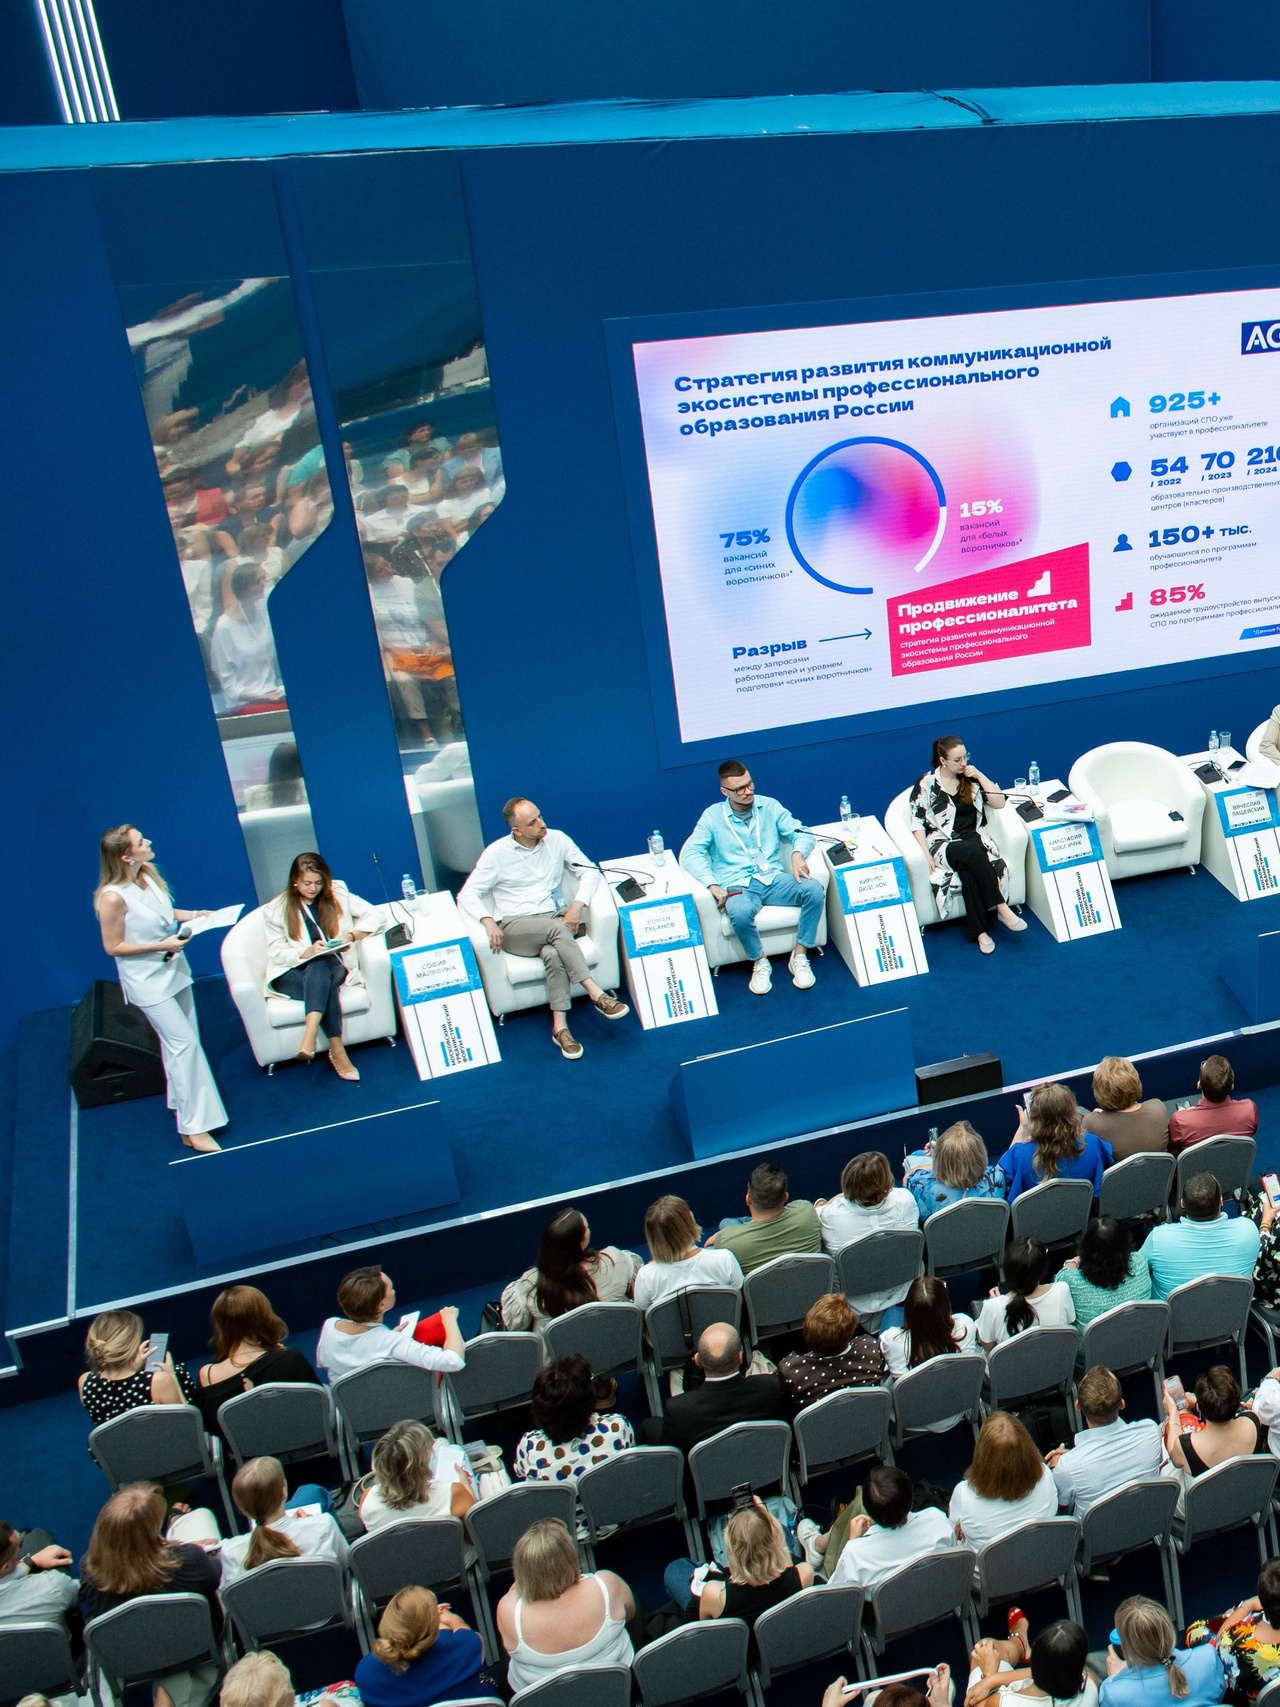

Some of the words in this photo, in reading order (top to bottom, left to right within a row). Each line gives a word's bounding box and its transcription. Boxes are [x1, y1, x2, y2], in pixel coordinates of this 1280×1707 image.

[674, 369, 797, 393] Стратегия
[801, 358, 904, 383] развития
[908, 336, 1112, 369] коммуникационной
[677, 388, 818, 414] экосистемы
[822, 366, 1040, 401] профессионального
[1149, 390, 1221, 414] 925+
[679, 409, 830, 437] образования
[833, 400, 914, 419] России
[1150, 417, 1199, 430] организаций
[1200, 415, 1218, 424] СПО
[1218, 415, 1234, 425] уже
[1150, 430, 1188, 441] участвуют
[1195, 421, 1269, 436] профессионалитете
[1150, 456, 1189, 477] 54
[1200, 450, 1236, 471] 70
[1157, 478, 1182, 487] 2022
[1208, 471, 1232, 481] 2023
[1254, 466, 1278, 475] 2024
[960, 498, 1004, 518] 15%
[1151, 501, 1182, 511] центров
[1183, 496, 1225, 508] (кластеров)
[960, 519, 1000, 531] вакансий
[719, 528, 771, 549] 75%
[960, 534, 976, 543] для
[978, 530, 1008, 540] «белых
[1149, 525, 1215, 548] 150+
[1219, 525, 1252, 537] тыс.
[723, 550, 768, 563] вакансий
[1149, 549, 1200, 561] обучающихся
[1211, 542, 1257, 554] программам
[724, 566, 742, 575] для
[744, 562, 776, 572] «синих
[1150, 555, 1223, 571] профессионалитета
[897, 590, 1019, 618] Продвижение
[1149, 583, 1206, 607] 85%
[899, 598, 1078, 635] профессионалитета
[1150, 609, 1192, 619] ожидаемое
[1192, 599, 1252, 615] трудоустройство
[1150, 619, 1167, 629] СПО
[1178, 612, 1225, 625] программам
[900, 636, 940, 649] стратегия
[941, 631, 977, 644] развития
[978, 618, 1055, 636] коммуникационной
[732, 640, 808, 660] Разрыв
[901, 645, 948, 659] экосистемы
[949, 633, 1028, 651] профессионального
[734, 664, 763, 673] между
[763, 656, 810, 669] запросами
[901, 655, 954, 669] образования
[955, 650, 984, 660] России
[735, 668, 798, 684] работодателей
[806, 661, 843, 673] уровнем
[736, 680, 785, 693] подготовки
[816, 667, 873, 681] воротничков»
[1232, 800, 1261, 811] ВЯЧЕСЛАВ
[644, 922, 676, 933] ГУБАНОВ
[647, 916, 671, 925] РОМАН
[876, 932, 889, 972] МОСКОВСКИЙ
[890, 947, 899, 970] ФОРУМ
[421, 959, 447, 970] СОФИЯ
[666, 976, 678, 1018] МОСКОВСКИЙ
[667, 957, 684, 1016] УРБАНИСТИЧЕСКИЙ
[681, 992, 689, 1015] ФОРУМ
[441, 1023, 456, 1066] МОСКОВСКИЙ
[442, 1003, 462, 1065] УРБАНИСТИЧЕСКИЙ
[458, 1040, 468, 1063] ФОРУМ
